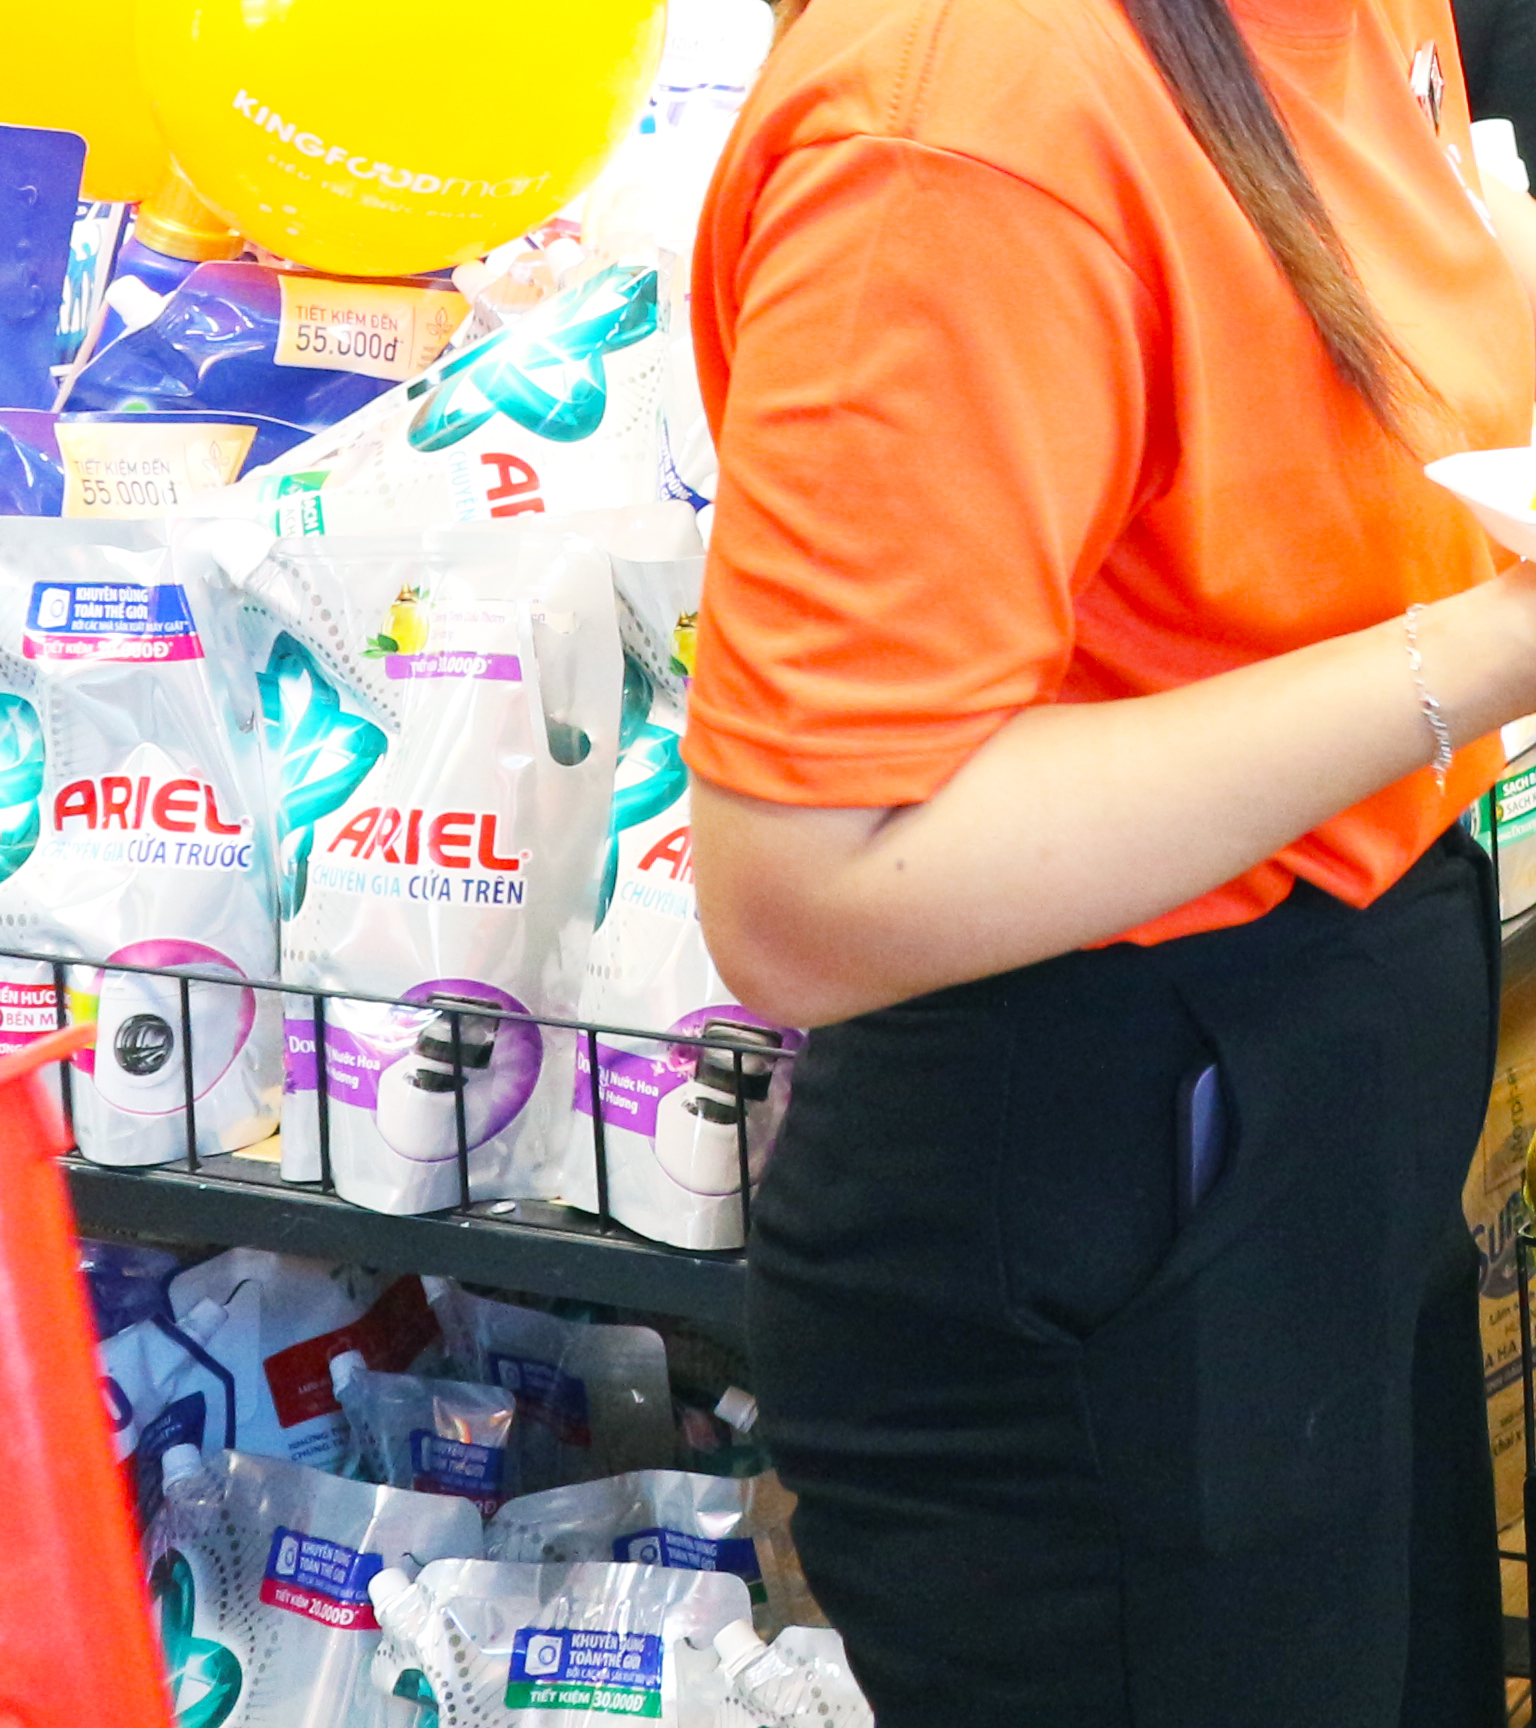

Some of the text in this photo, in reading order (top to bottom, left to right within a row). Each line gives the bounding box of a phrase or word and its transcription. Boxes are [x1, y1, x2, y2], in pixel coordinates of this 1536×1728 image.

[295, 305, 325, 322] TIẾT
[371, 313, 398, 331] ĐẾN
[74, 602, 103, 618] TOÀN
[105, 601, 125, 619] THẾ
[53, 776, 242, 836] ARIEL
[128, 832, 166, 865] CỬA
[175, 840, 252, 868] TRƯỚC
[326, 807, 520, 871] ARIEL
[371, 874, 401, 898] GIA
[408, 869, 451, 902] CỬA
[462, 875, 524, 905] TRÊN
[357, 1053, 381, 1071] Hoa
[636, 1077, 660, 1098] Hoa
[569, 1649, 599, 1667] TOÀN
[530, 1686, 556, 1703] TIẾT
[558, 1691, 591, 1706] KIỆM
